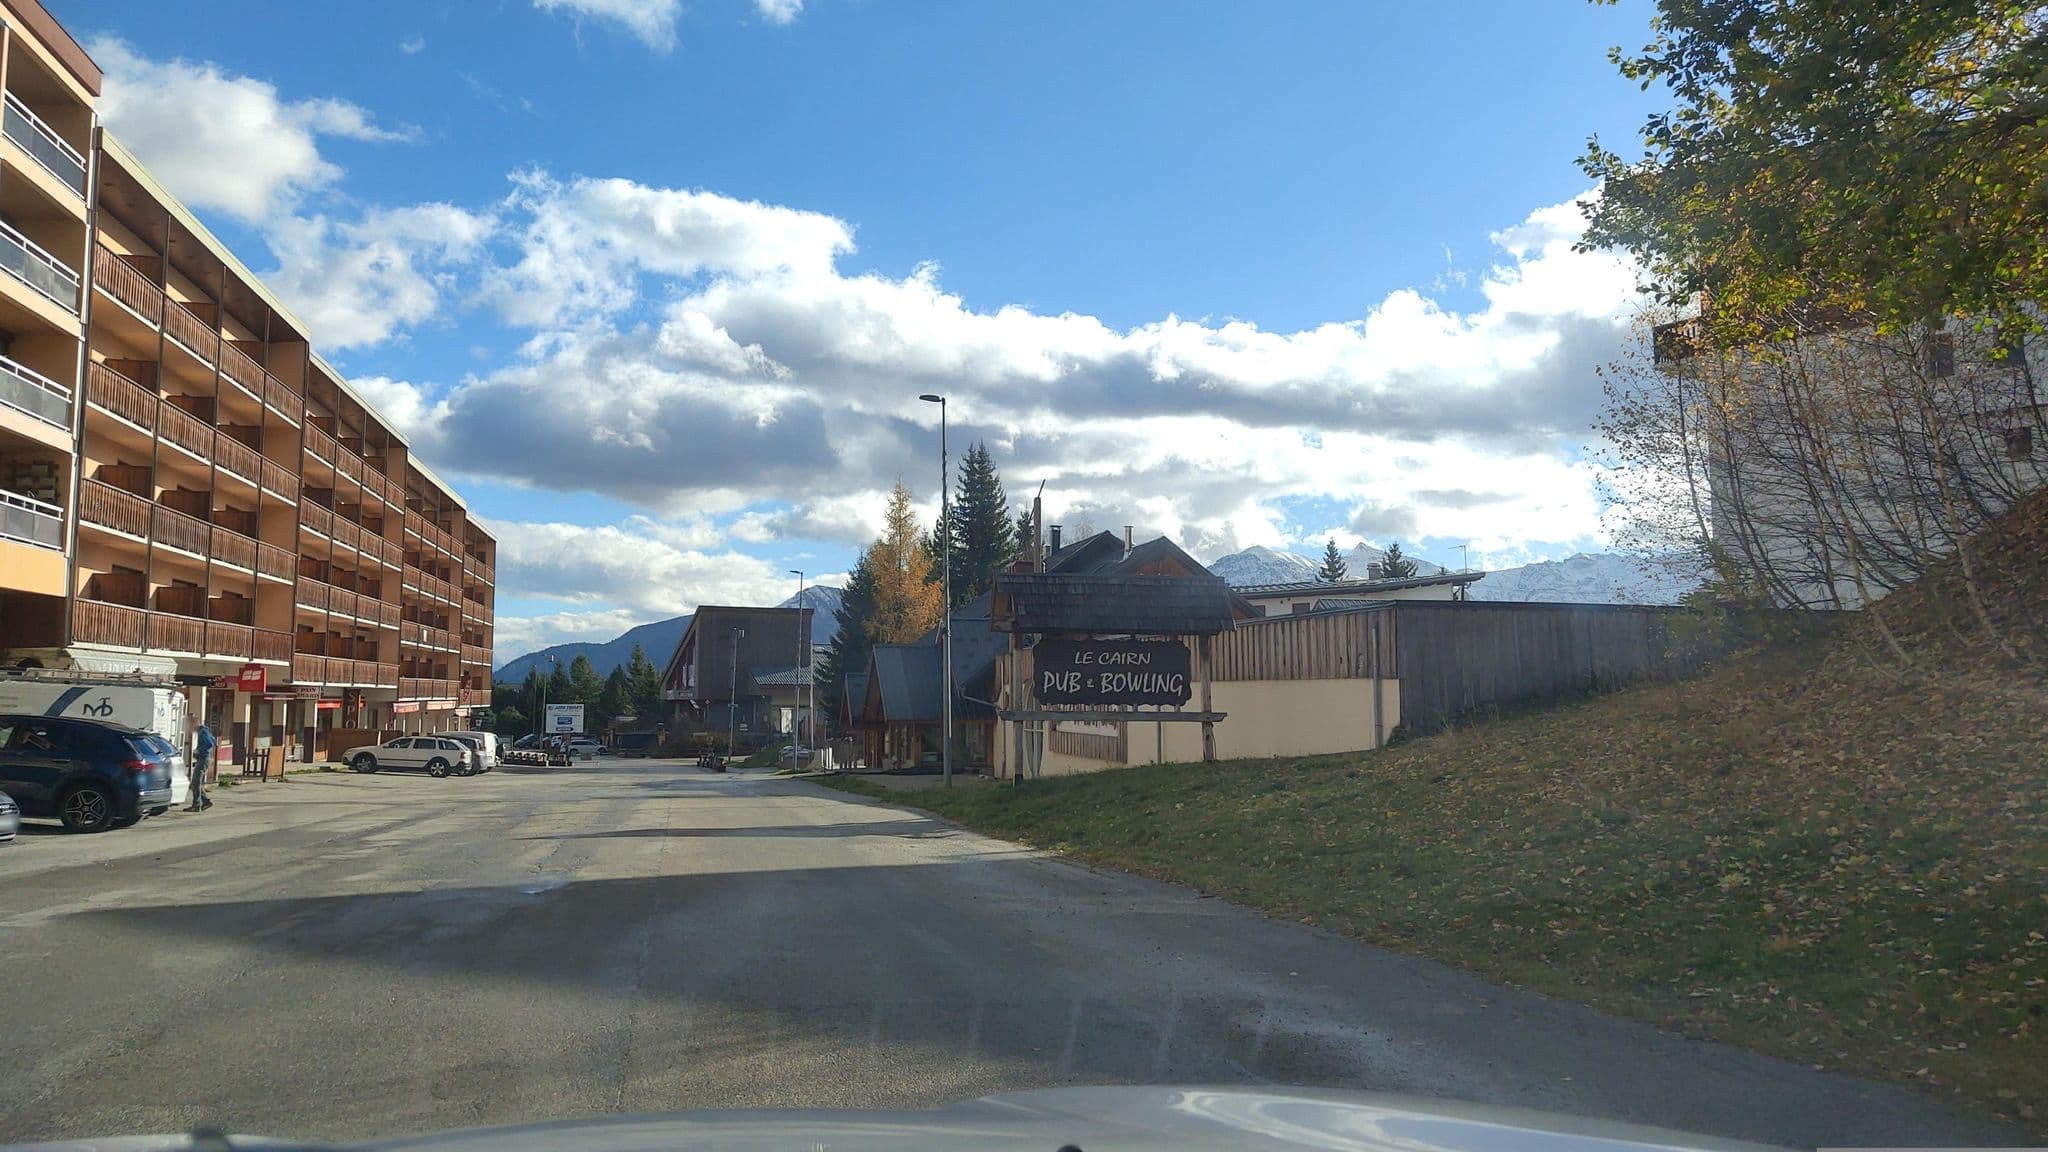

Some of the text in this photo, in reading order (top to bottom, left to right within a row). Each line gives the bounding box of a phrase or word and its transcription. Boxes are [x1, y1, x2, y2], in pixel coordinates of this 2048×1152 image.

[1074, 651, 1151, 665] LE CAIRN
[1043, 670, 1082, 694] PUB
[1100, 671, 1183, 697] BOWLING
